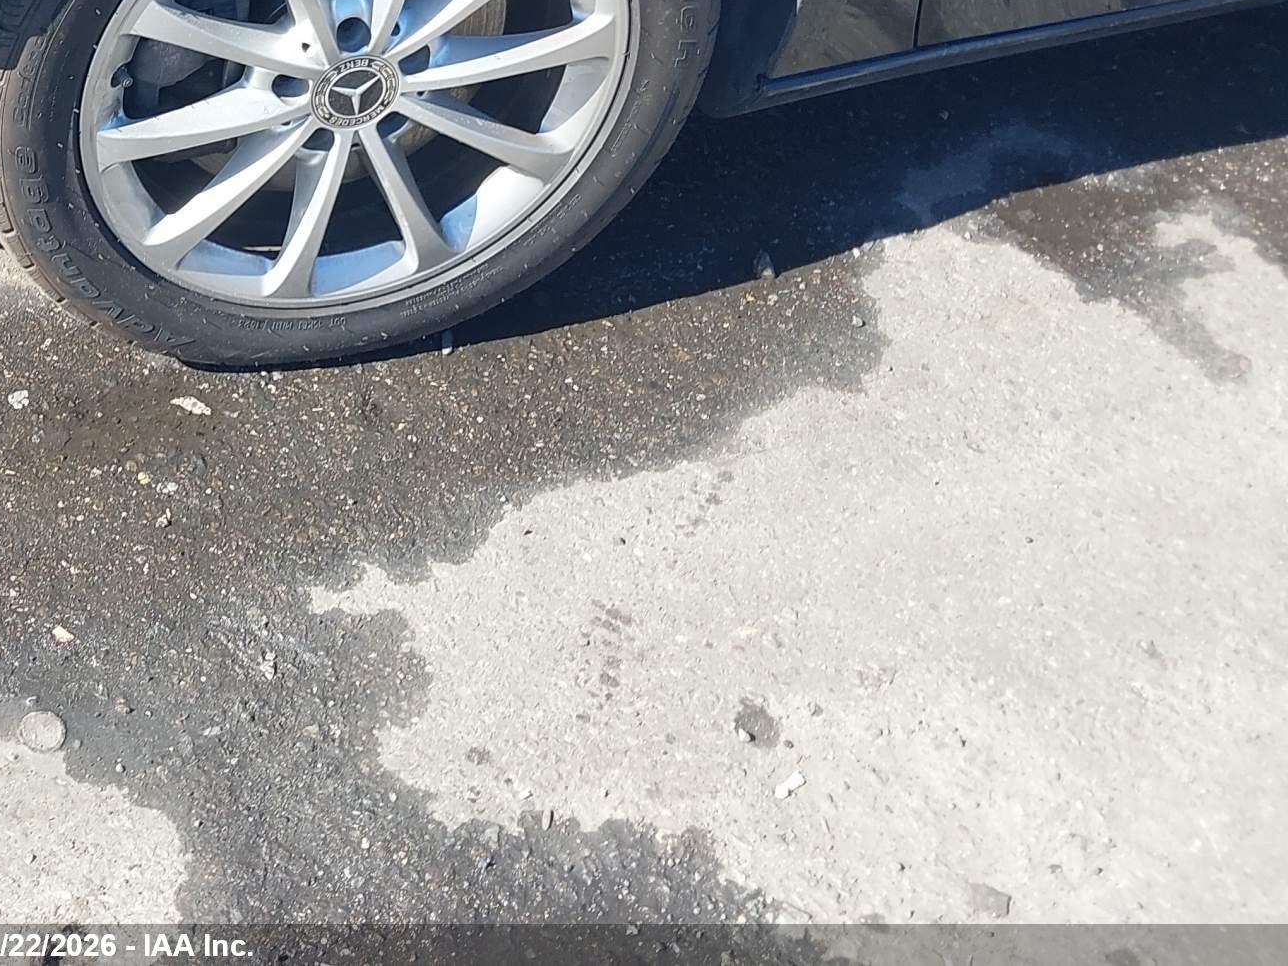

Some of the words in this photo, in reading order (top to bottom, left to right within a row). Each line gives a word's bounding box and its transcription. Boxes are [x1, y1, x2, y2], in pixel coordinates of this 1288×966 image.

[339, 58, 370, 73] BENZ
[328, 104, 385, 126] MERCEDES
[14, 145, 196, 346] Advantage
